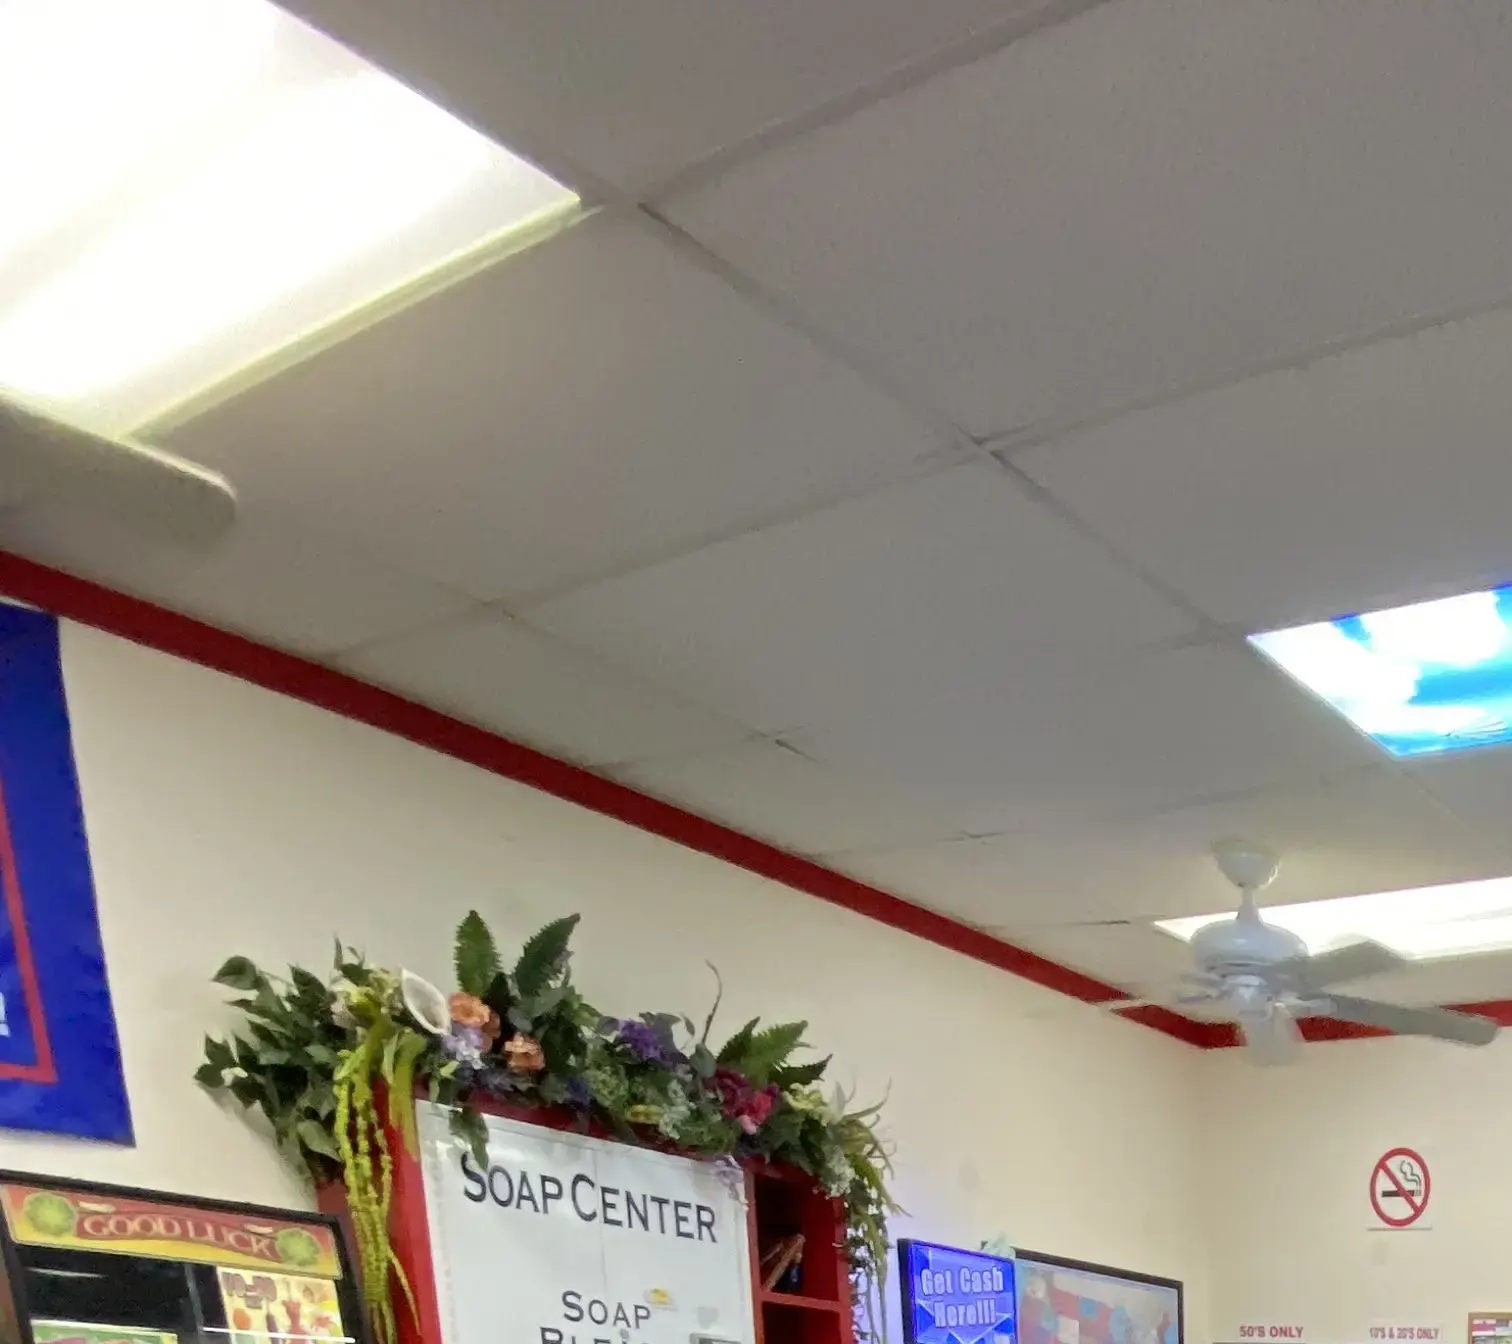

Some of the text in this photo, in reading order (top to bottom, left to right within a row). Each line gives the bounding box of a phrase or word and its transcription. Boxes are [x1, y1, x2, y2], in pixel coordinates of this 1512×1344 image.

[461, 1151, 718, 1243] SOAP CENTER
[84, 1213, 273, 1258] GOOD LUCK
[921, 1266, 1004, 1296] Get Cash
[561, 1290, 651, 1329] SOAP
[1239, 1326, 1304, 1339] 50'S ONLY
[1416, 1328, 1439, 1340] ONLY
